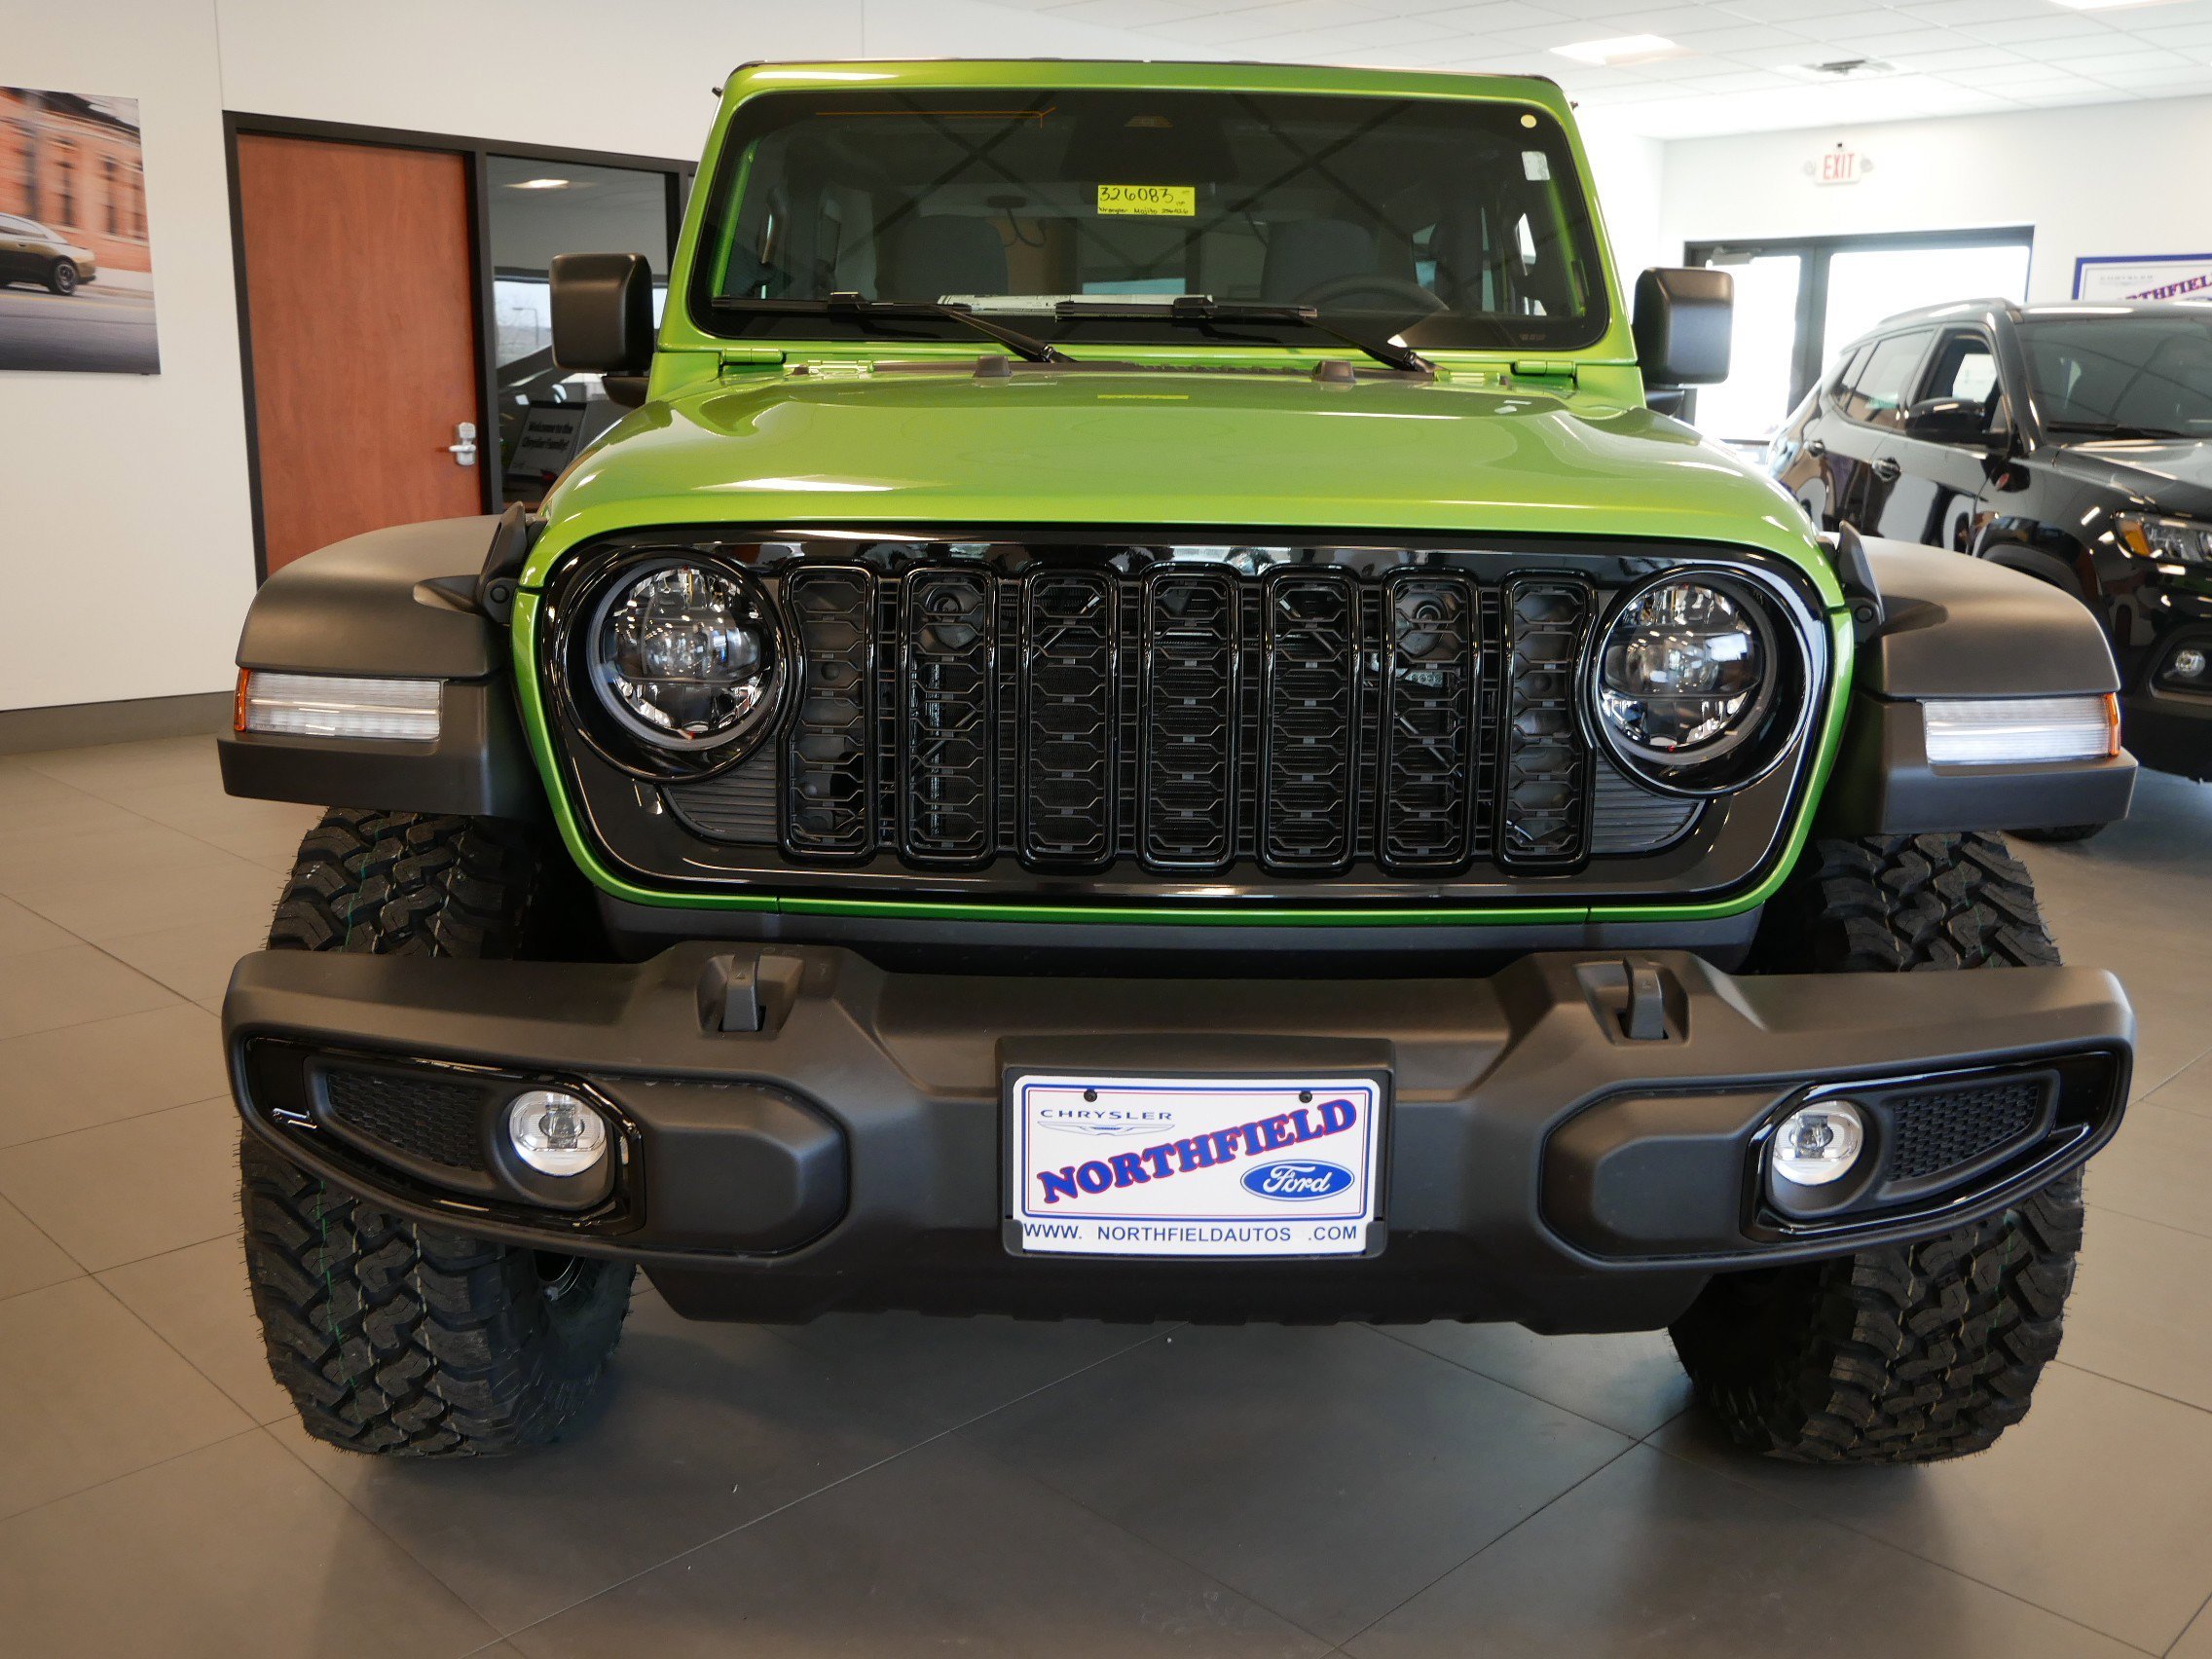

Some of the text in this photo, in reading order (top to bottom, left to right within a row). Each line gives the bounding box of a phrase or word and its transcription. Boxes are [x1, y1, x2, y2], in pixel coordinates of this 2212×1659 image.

[1823, 153, 1855, 179] EXIT
[1099, 187, 1174, 203] 326083
[1040, 1109, 1172, 1121] CHRYSLER
[1037, 1099, 1357, 1203] NORTHFIELD
[1263, 1164, 1333, 1193] Ford
[1024, 1224, 1357, 1242] WWW. NORTHFIELDAUTOS .COM
